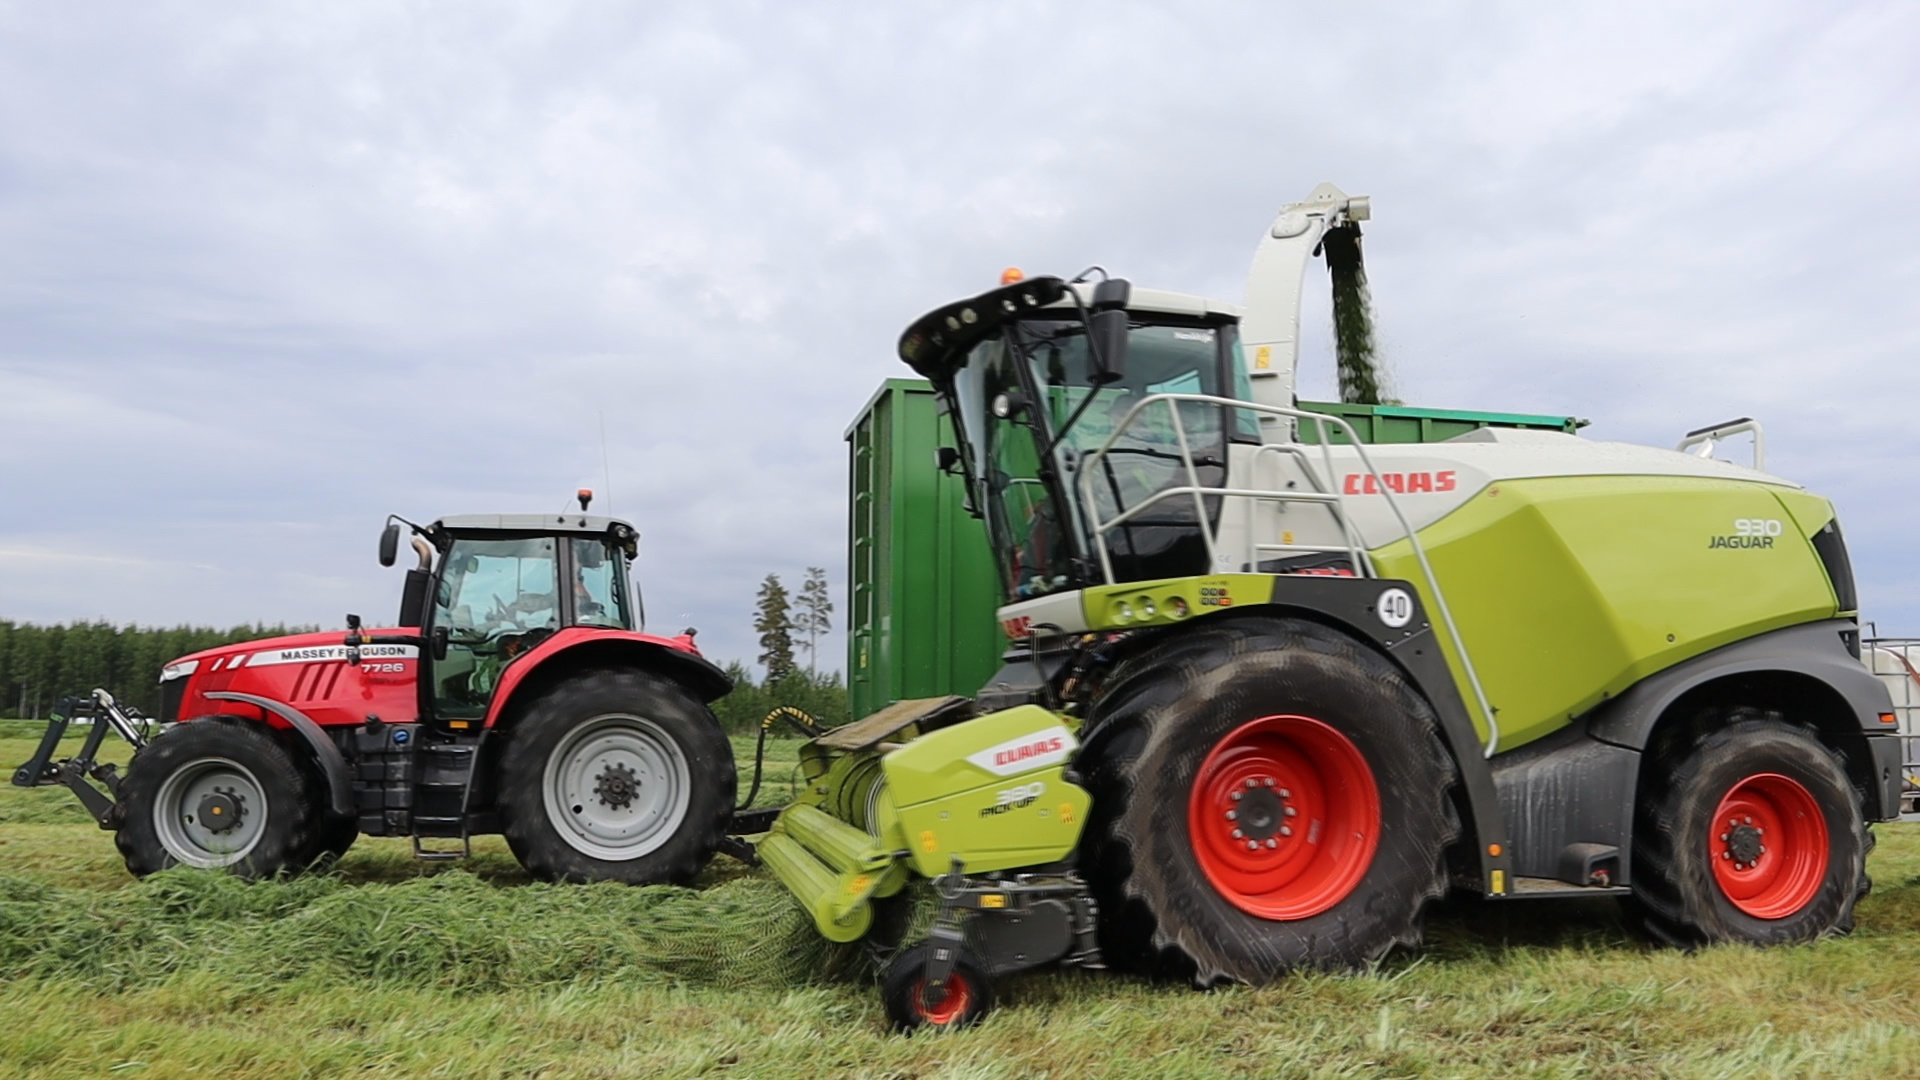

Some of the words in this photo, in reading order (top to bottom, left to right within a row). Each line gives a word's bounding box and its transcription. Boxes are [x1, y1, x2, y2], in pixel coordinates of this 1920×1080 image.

[1343, 471, 1456, 495] CLAAS
[1735, 519, 1782, 536] 930
[1708, 536, 1774, 549] JAGUAR
[1384, 595, 1407, 618] 40
[281, 649, 334, 660] MASSEY
[338, 647, 406, 658] FEGUSON
[361, 663, 404, 673] 7726
[994, 737, 1062, 766] CLAAS
